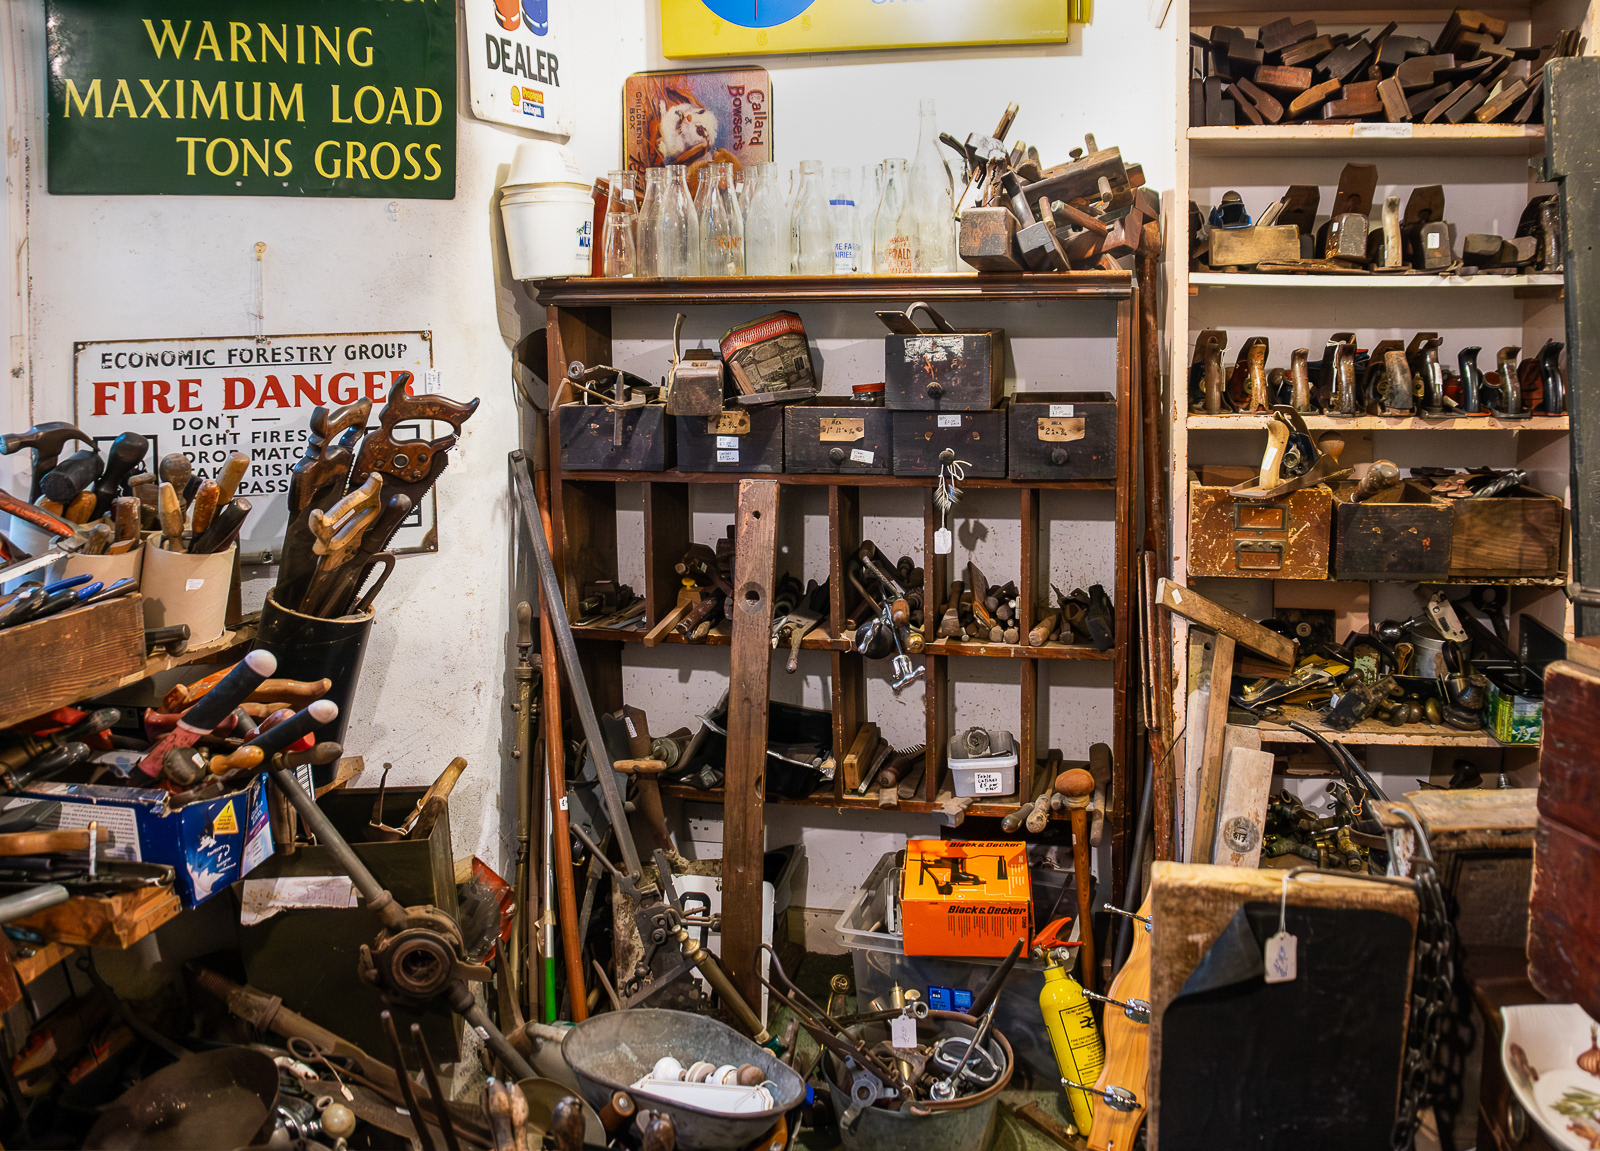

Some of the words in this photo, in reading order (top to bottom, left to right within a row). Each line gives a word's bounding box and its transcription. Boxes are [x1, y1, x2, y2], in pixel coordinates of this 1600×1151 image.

[712, 20, 723, 36] 7
[801, 15, 811, 31] 5
[141, 19, 374, 67] WARNING
[757, 30, 768, 45] 6
[485, 33, 560, 87] DEALER
[63, 78, 306, 122] MAXIMUM
[331, 84, 443, 126] LOAD
[728, 85, 745, 151] Bowser's
[746, 89, 767, 146] Callard
[176, 137, 293, 177] TONS
[314, 140, 442, 181] GROSS
[579, 236, 591, 247] MILK
[101, 349, 216, 370] ECONOMIC
[228, 345, 337, 364] FORESTRY
[344, 343, 408, 361] GROUP
[90, 378, 203, 416] FIRE
[172, 413, 239, 431] DON'T
[181, 432, 240, 447] LIGHT
[251, 429, 308, 444] FIRES
[183, 449, 239, 463] DRO
[251, 446, 305, 461] MATC
[191, 466, 224, 479] AK
[251, 463, 297, 477] RISK
[238, 479, 289, 494] PASS
